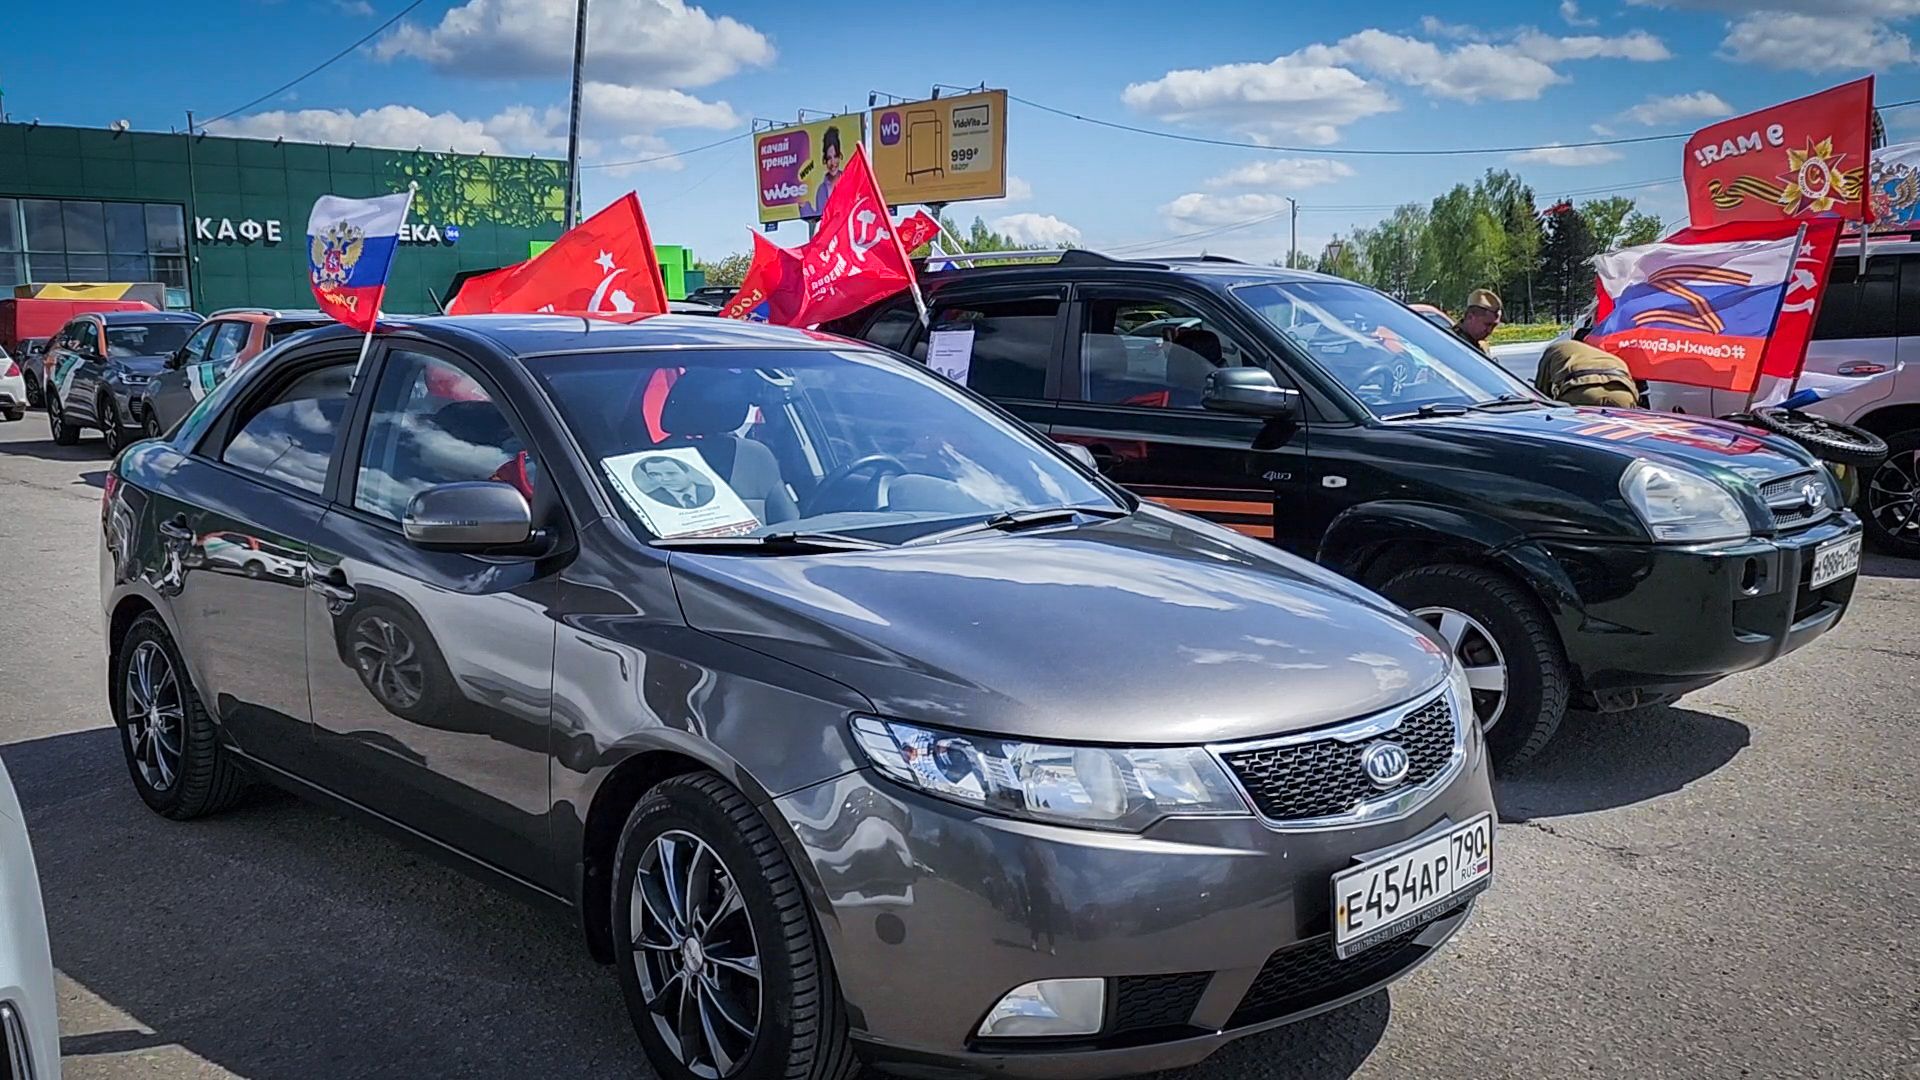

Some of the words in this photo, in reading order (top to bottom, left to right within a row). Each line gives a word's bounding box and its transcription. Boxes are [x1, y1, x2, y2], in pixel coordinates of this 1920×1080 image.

[881, 117, 900, 138] wb
[761, 137, 789, 155] качай
[762, 154, 797, 171] тренды
[763, 183, 808, 201] wibes
[195, 217, 282, 242] КАФЕ
[399, 224, 441, 242] ЕКА
[1373, 750, 1405, 777] KIA
[1346, 855, 1448, 932] Е454АР
[1453, 825, 1485, 871] 790
[1460, 863, 1478, 881] RUS
